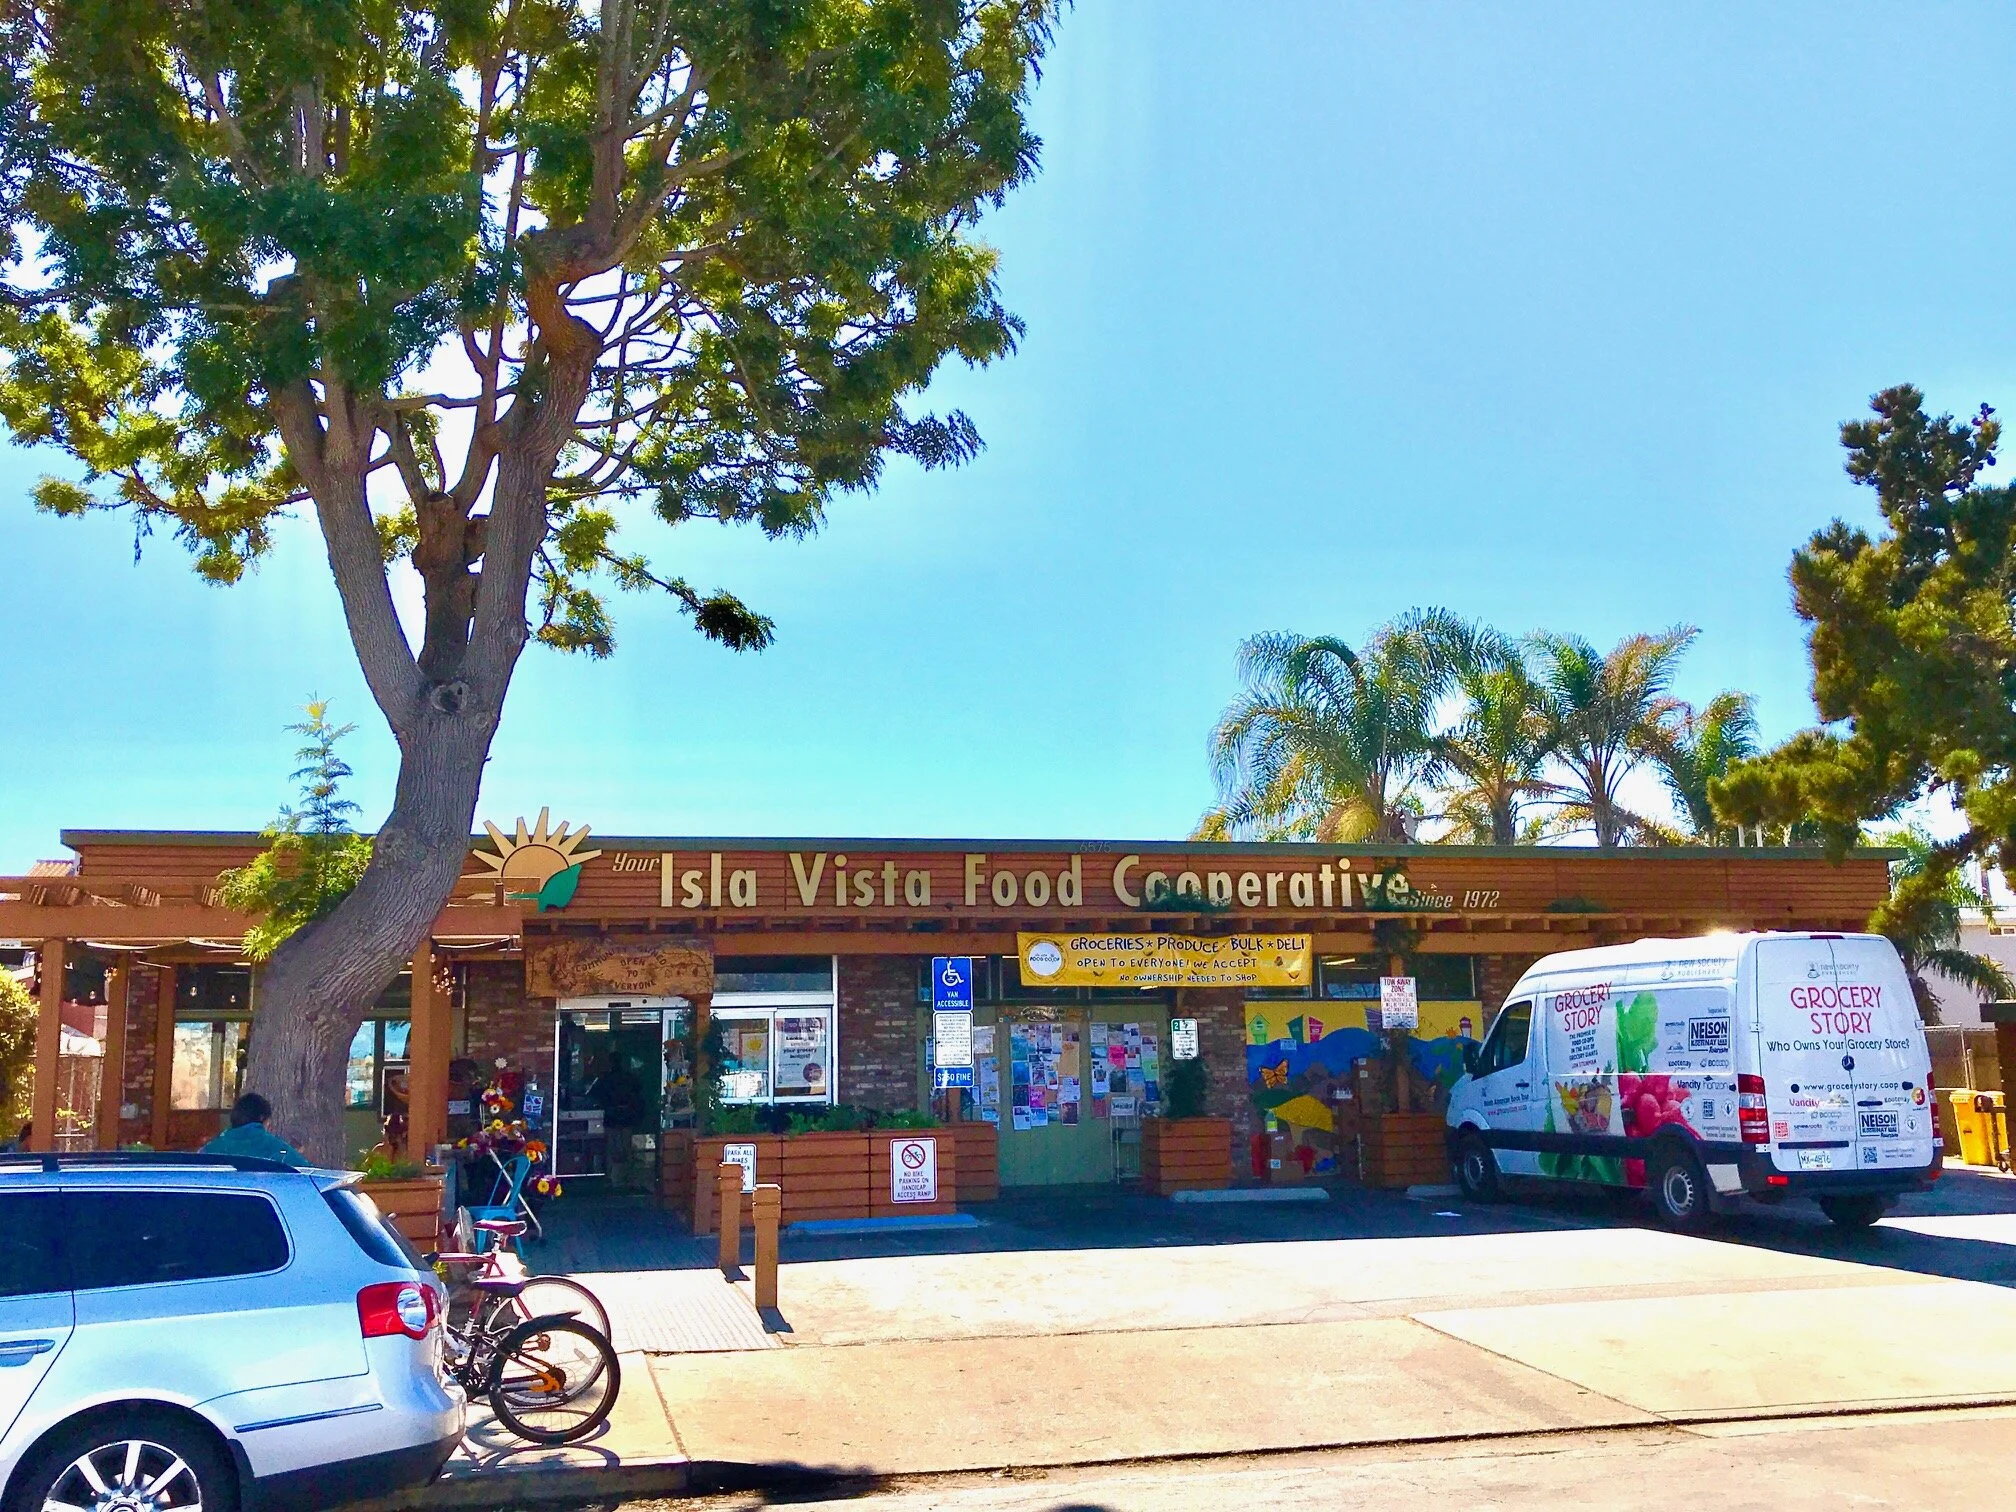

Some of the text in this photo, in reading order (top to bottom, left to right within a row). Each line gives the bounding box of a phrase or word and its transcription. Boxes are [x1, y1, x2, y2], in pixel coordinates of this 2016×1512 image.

[1079, 841, 1113, 854] 6575
[612, 852, 660, 872] Your
[660, 852, 1410, 908] Isla Vista Food Cooperative
[1410, 889, 1500, 908] Since 1972
[1070, 936, 1306, 953] GROCERIES PRODUCE BULK DELI
[619, 956, 646, 967] OPEN
[1076, 957, 1257, 969] OPEN TO EVERYONE! WE ACCEPT
[626, 969, 639, 978] TO
[1119, 974, 1130, 982] NO
[1133, 973, 1184, 982] OWNERSHIP
[1187, 974, 1217, 983] NEEDED
[1220, 974, 1232, 982] TO
[1384, 978, 1412, 986] TOW AWAY
[946, 991, 959, 999] VAN
[1391, 985, 1405, 993] ZONE
[1554, 981, 1612, 1013] GROCERY
[1790, 986, 1881, 1009] GROCERY
[936, 999, 969, 1008] ACCESSIBLE
[1564, 1005, 1602, 1032] STORY
[1810, 1012, 1872, 1035] STORY
[1173, 1021, 1179, 1030] 2
[1690, 1021, 1728, 1039] NELSON
[1767, 1037, 1910, 1052] Who Owns Your Grocery Store?
[956, 1072, 972, 1082] FINE
[1677, 1080, 1701, 1090] Vancity
[1803, 1082, 1899, 1092] www.grocerystory.coop
[1789, 1098, 1820, 1108] Vancity
[1861, 1113, 1897, 1127] NELSON
